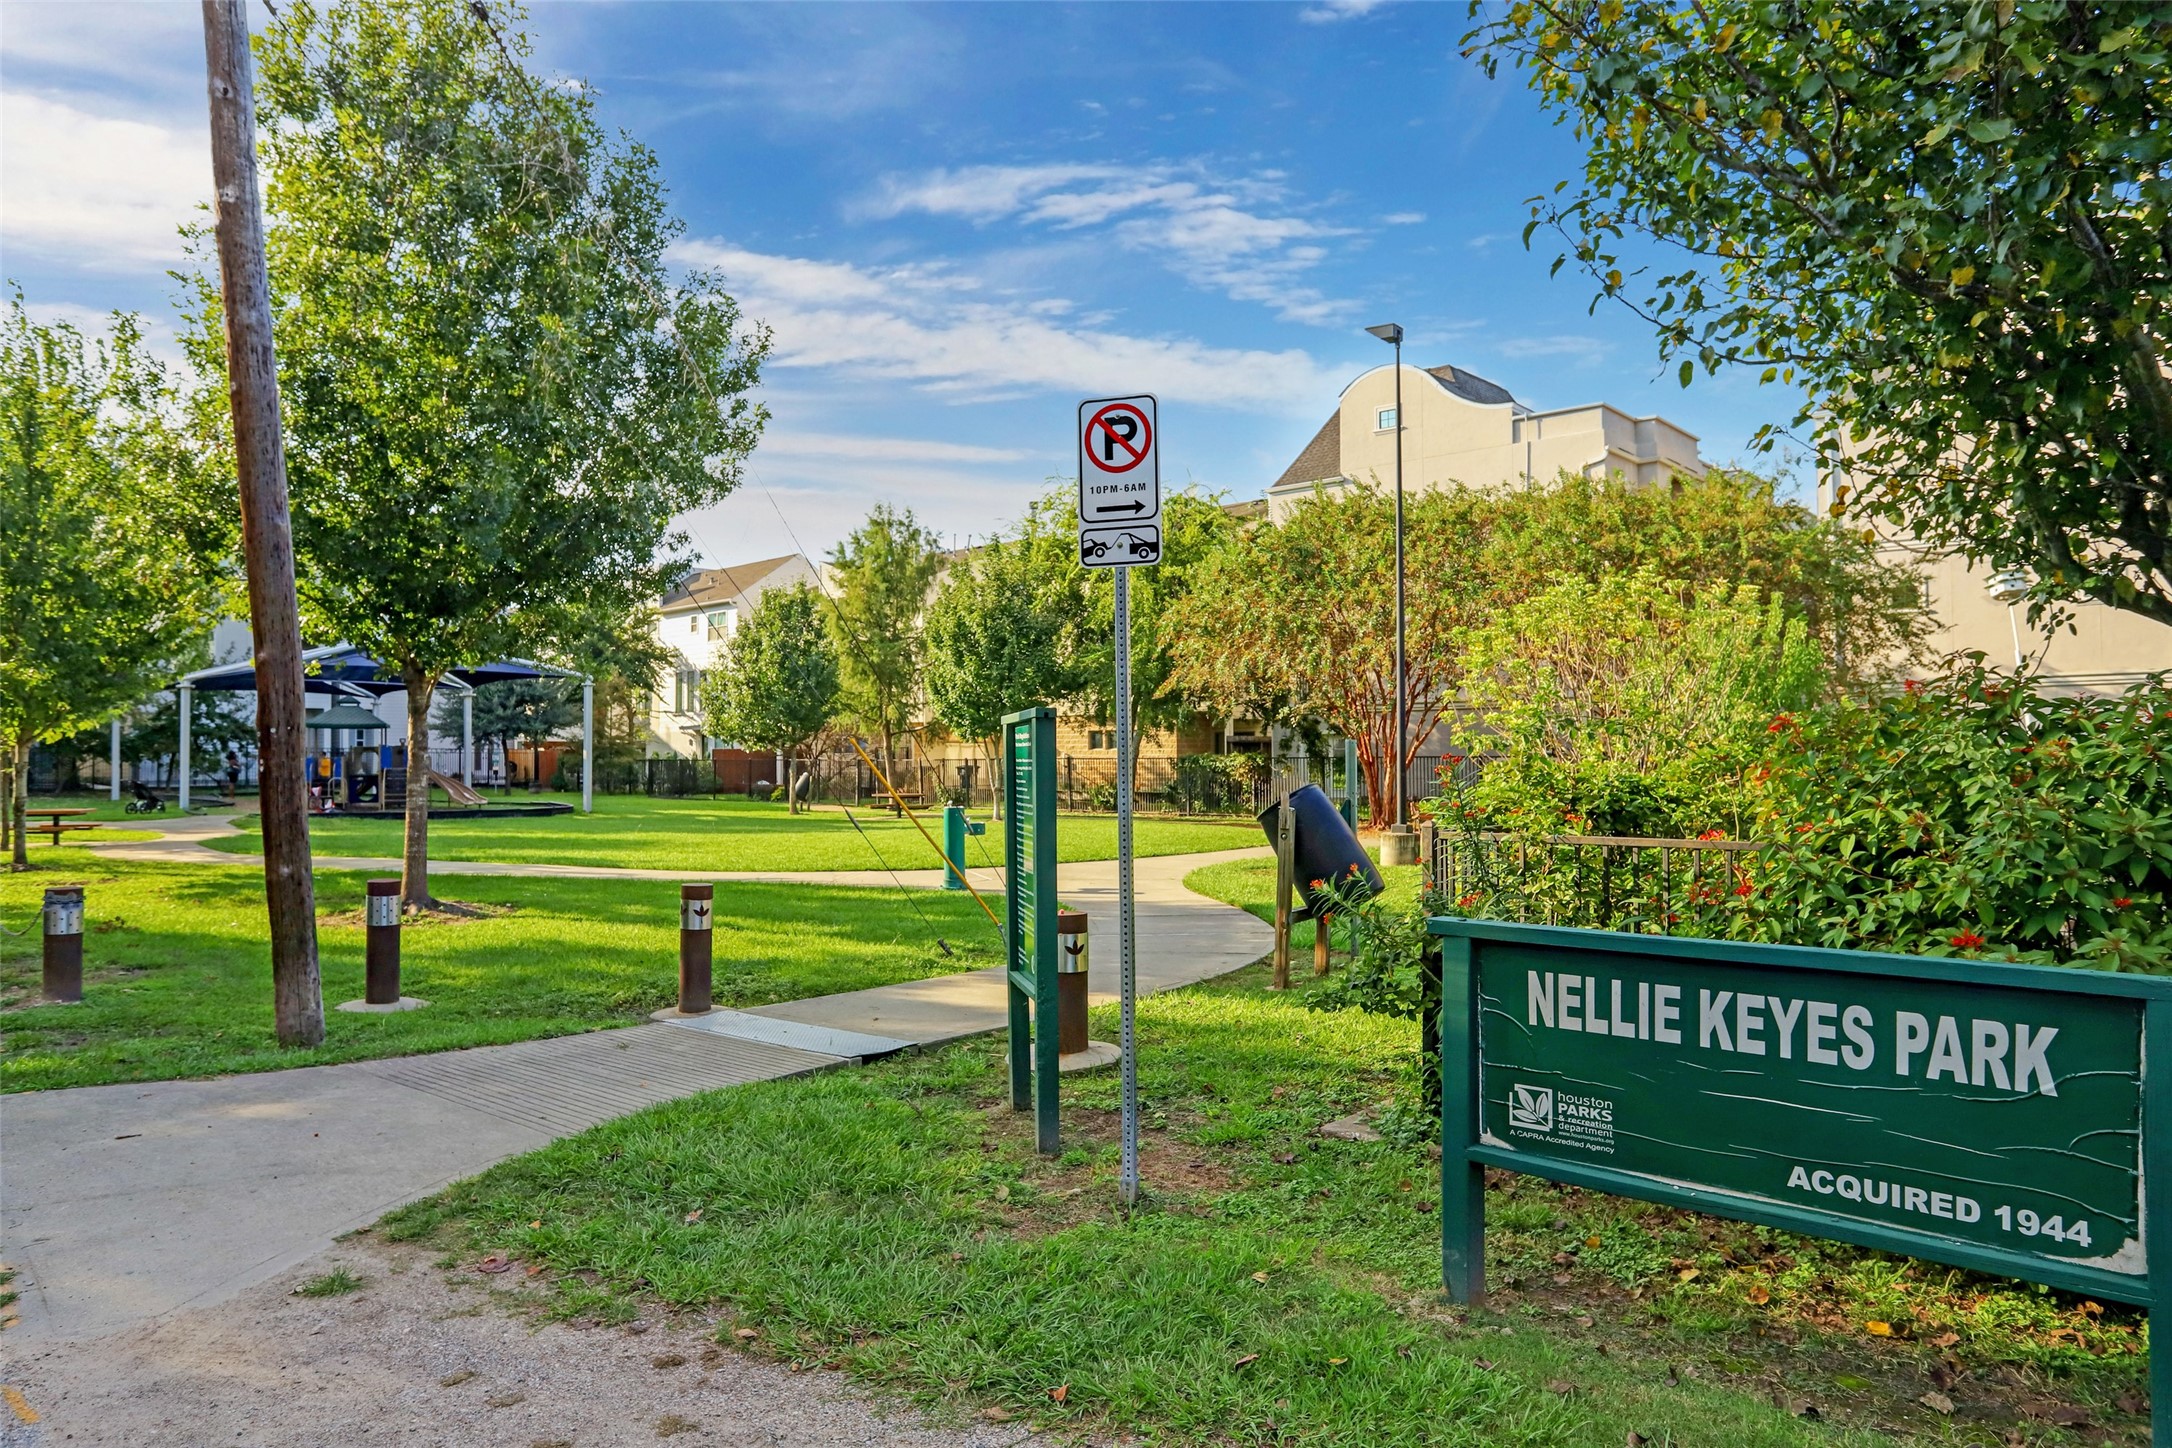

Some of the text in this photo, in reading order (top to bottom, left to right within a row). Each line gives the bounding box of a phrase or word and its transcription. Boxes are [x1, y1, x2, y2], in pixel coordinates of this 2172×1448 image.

[1089, 482, 1147, 495] 10PM-6AM
[1527, 970, 2060, 1098] NELLIE KEYES PARK
[1557, 1091, 1613, 1109] houston
[1557, 1103, 1613, 1122] PARKS
[1558, 1122, 1613, 1138] department
[1567, 1117, 1613, 1130] recreation
[1516, 1130, 1545, 1142] CAPRA
[1545, 1135, 1585, 1148] Accredited
[1585, 1142, 1615, 1155] Agency
[1786, 1165, 2092, 1248] ACQUIRED 1944
